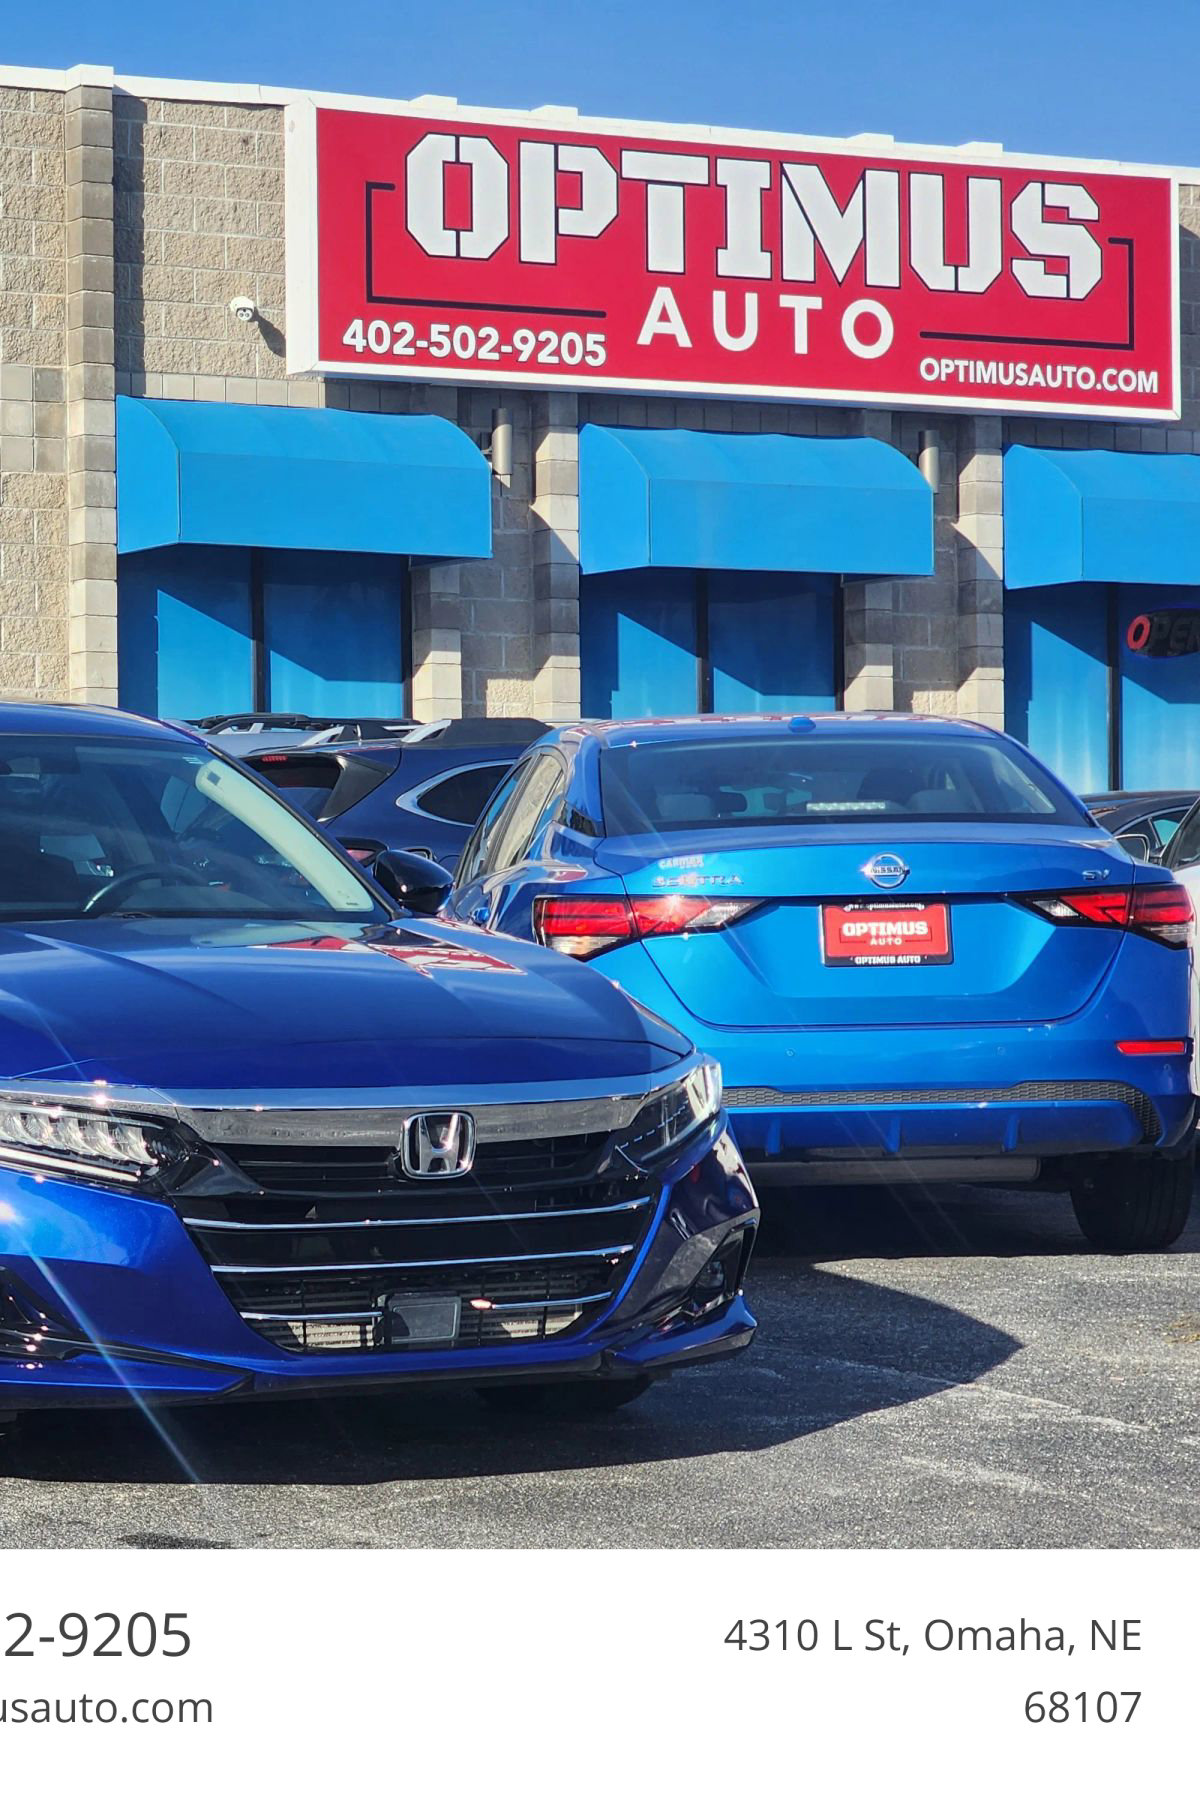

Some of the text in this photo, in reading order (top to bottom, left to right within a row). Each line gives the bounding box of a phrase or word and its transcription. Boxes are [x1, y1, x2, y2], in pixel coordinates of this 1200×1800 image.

[405, 132, 1103, 300] OPTIMUS
[636, 286, 894, 359] AUTO
[341, 317, 608, 368] 402-502-9205
[918, 356, 1160, 395] OPTIMUSAUTO.COM
[870, 865, 906, 874] NISSAN
[842, 921, 928, 936] OPTIMUS
[869, 936, 903, 946] AUTO
[897, 955, 921, 964] AUTO
